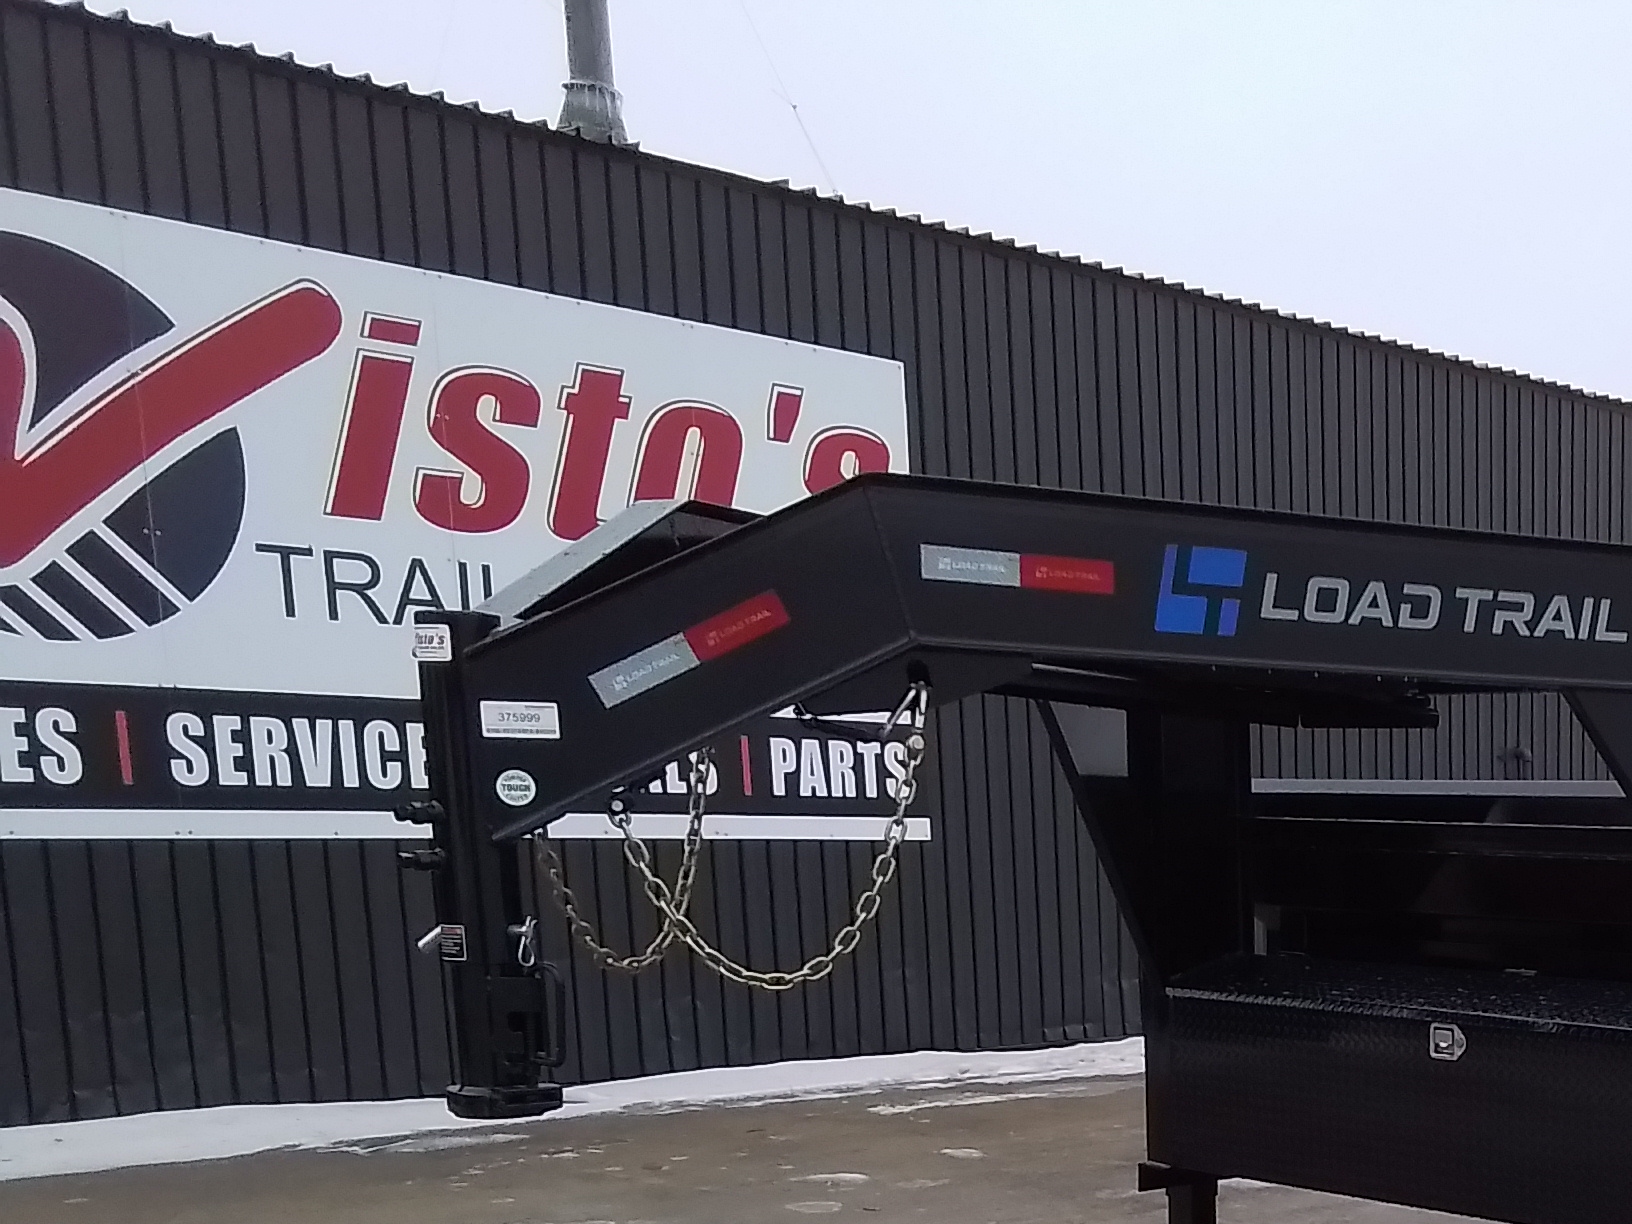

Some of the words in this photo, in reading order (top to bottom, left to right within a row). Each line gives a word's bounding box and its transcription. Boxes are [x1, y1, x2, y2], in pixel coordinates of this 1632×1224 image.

[1260, 572, 1443, 629] LOAD
[1455, 586, 1629, 643] TRAIL
[498, 712, 541, 722] 375999
[769, 737, 911, 798] PARTS
